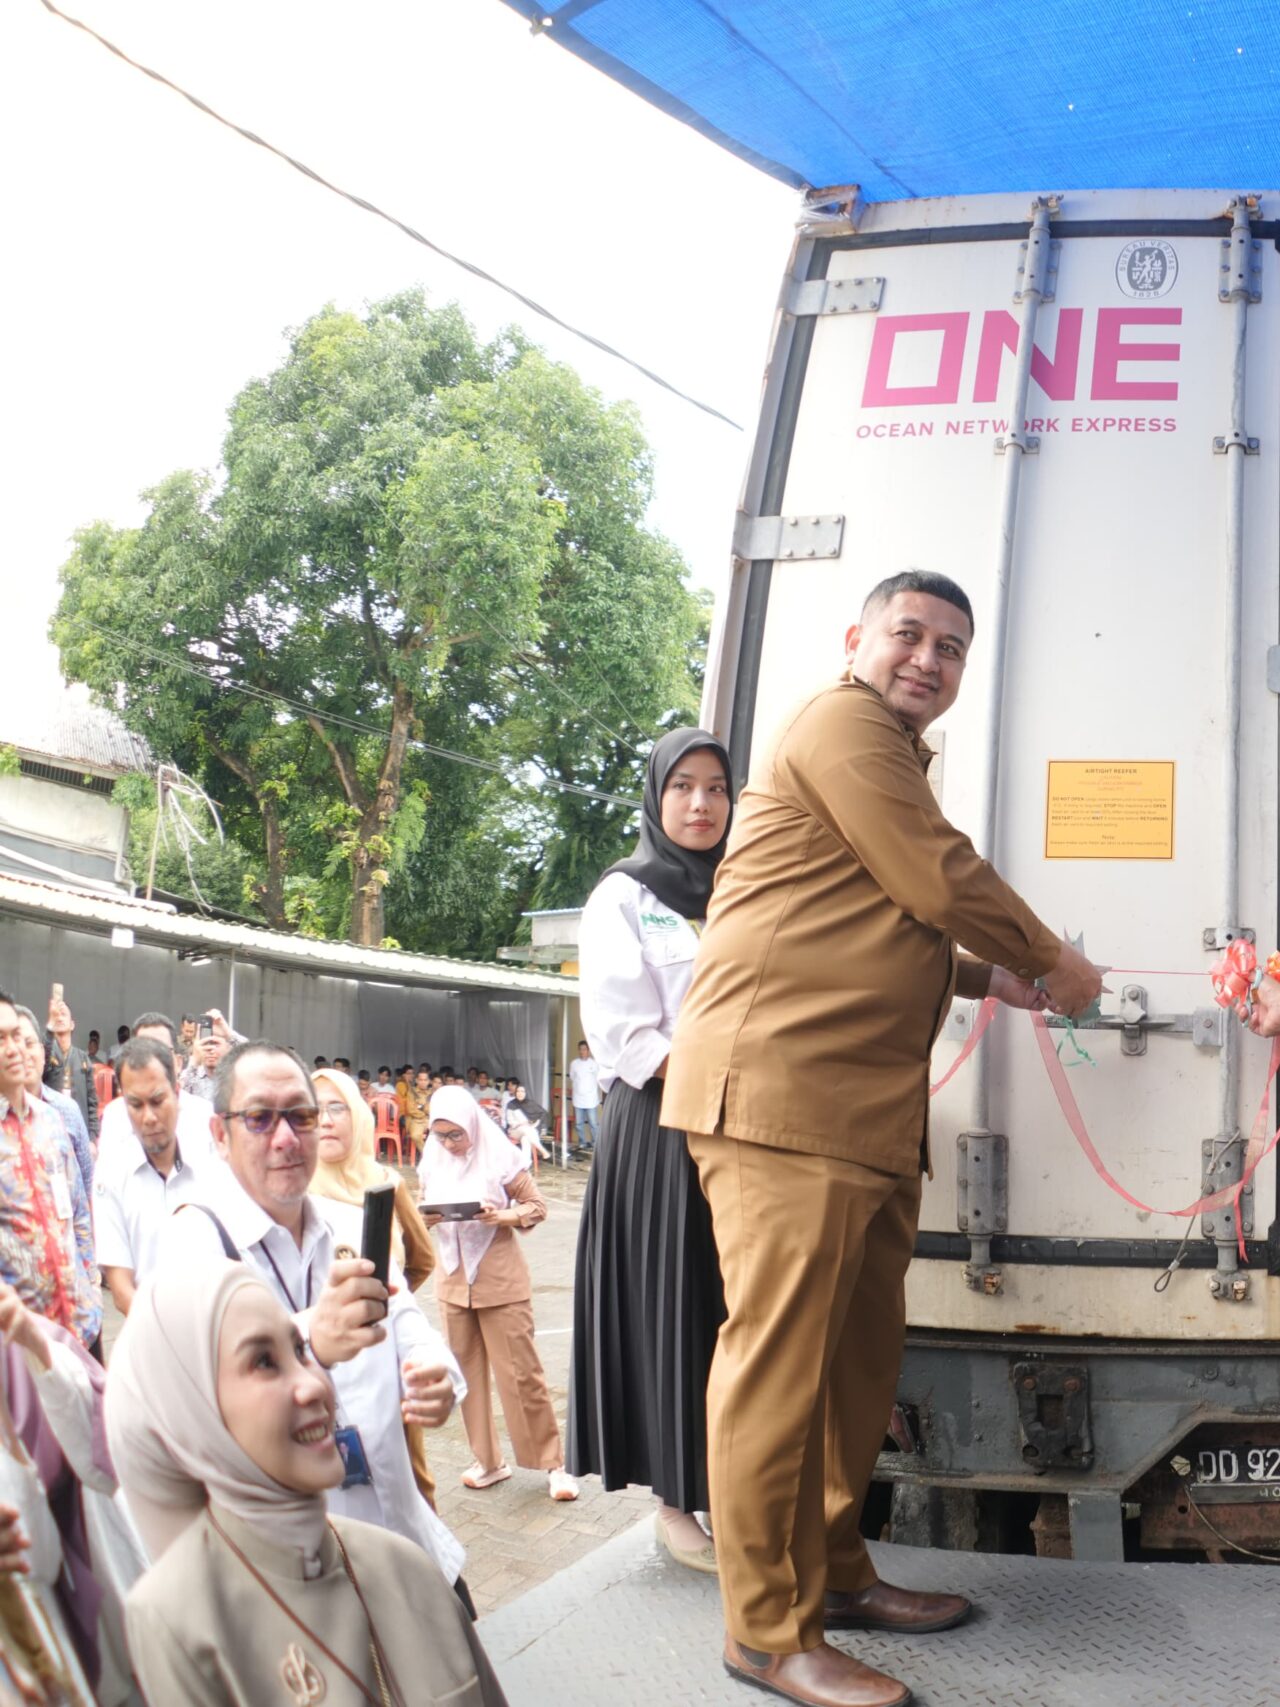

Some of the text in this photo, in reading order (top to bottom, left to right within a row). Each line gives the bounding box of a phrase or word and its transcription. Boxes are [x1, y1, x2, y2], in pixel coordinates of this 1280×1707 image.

[861, 307, 1182, 408] ONE
[856, 417, 1178, 439] OCEAN NETWRK EXPRESS
[1197, 1450, 1239, 1483] DD
